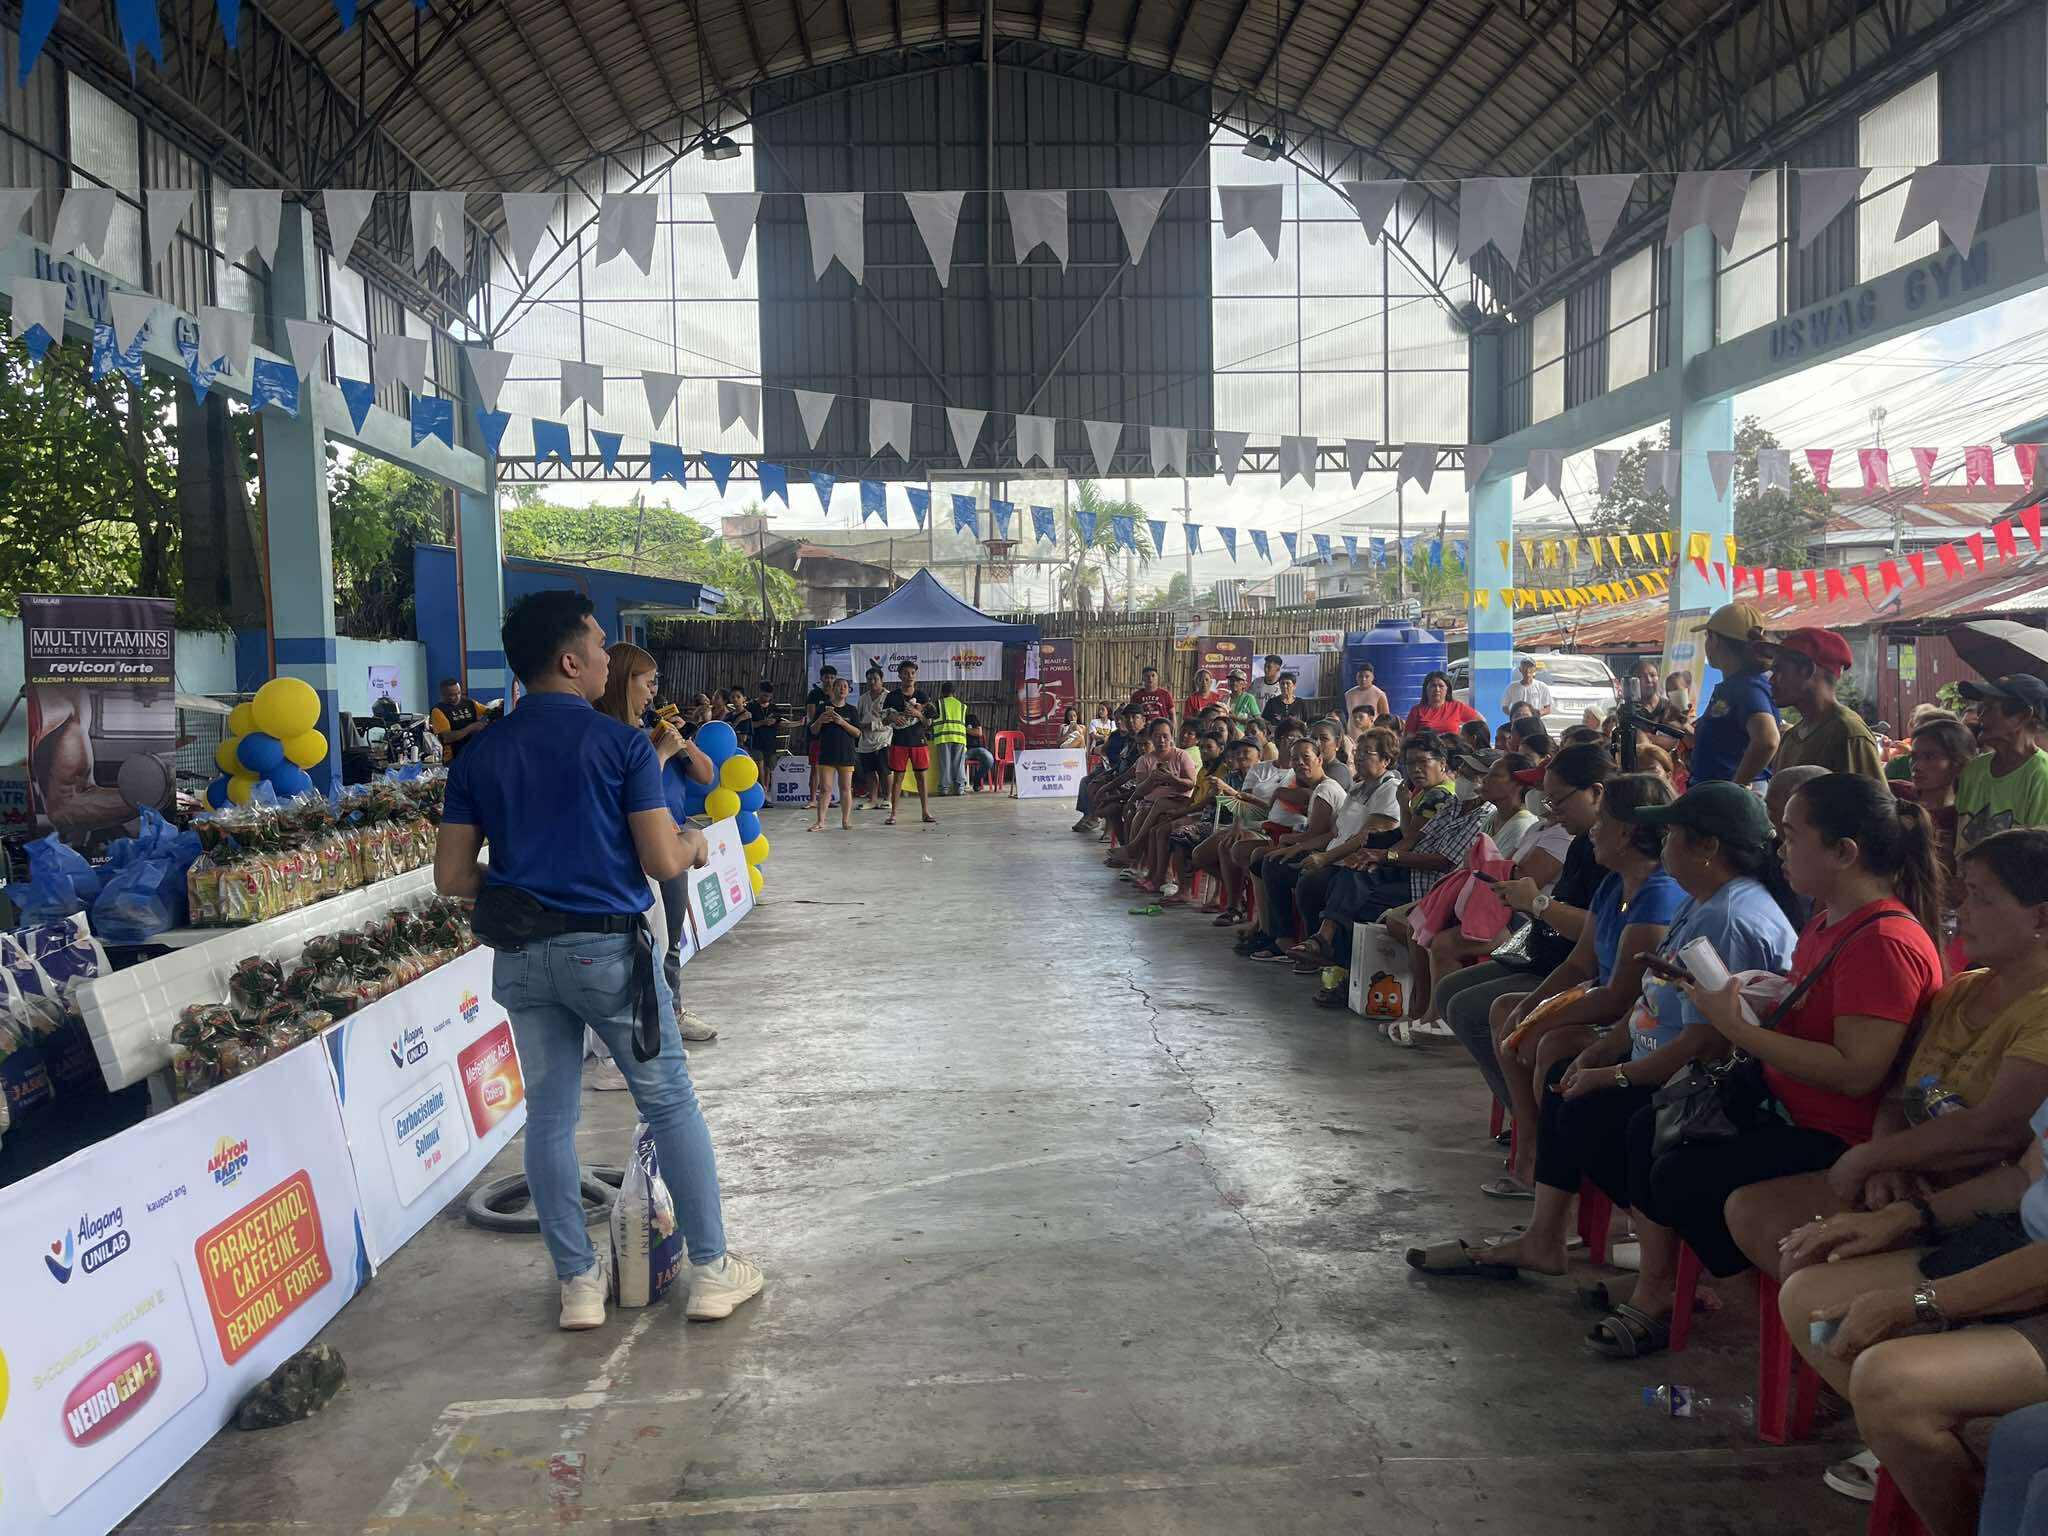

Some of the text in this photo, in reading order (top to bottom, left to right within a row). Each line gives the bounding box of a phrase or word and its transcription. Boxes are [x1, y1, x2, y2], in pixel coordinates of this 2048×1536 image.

[1769, 240, 1988, 363] USWAG GYM
[33, 630, 168, 648] MULTIVITAMINS
[34, 647, 87, 655] MINERALS
[138, 648, 168, 656] ACIDS
[49, 661, 154, 673] revicon forte
[777, 783, 799, 794] BP
[497, 1039, 511, 1058] Acid
[396, 1091, 445, 1139] Carbocisteine
[415, 1126, 440, 1157] Solmux
[214, 1153, 248, 1184] RADYO
[174, 1183, 188, 1197] ang
[77, 1205, 123, 1246] Alagang
[208, 1188, 308, 1280] PARACETAMOL
[84, 1233, 128, 1270] UNILAB
[232, 1225, 301, 1299] CAFFEINE
[226, 1252, 324, 1351] REXIDOL FORTE
[67, 1351, 157, 1439] NEUROGEN-E
